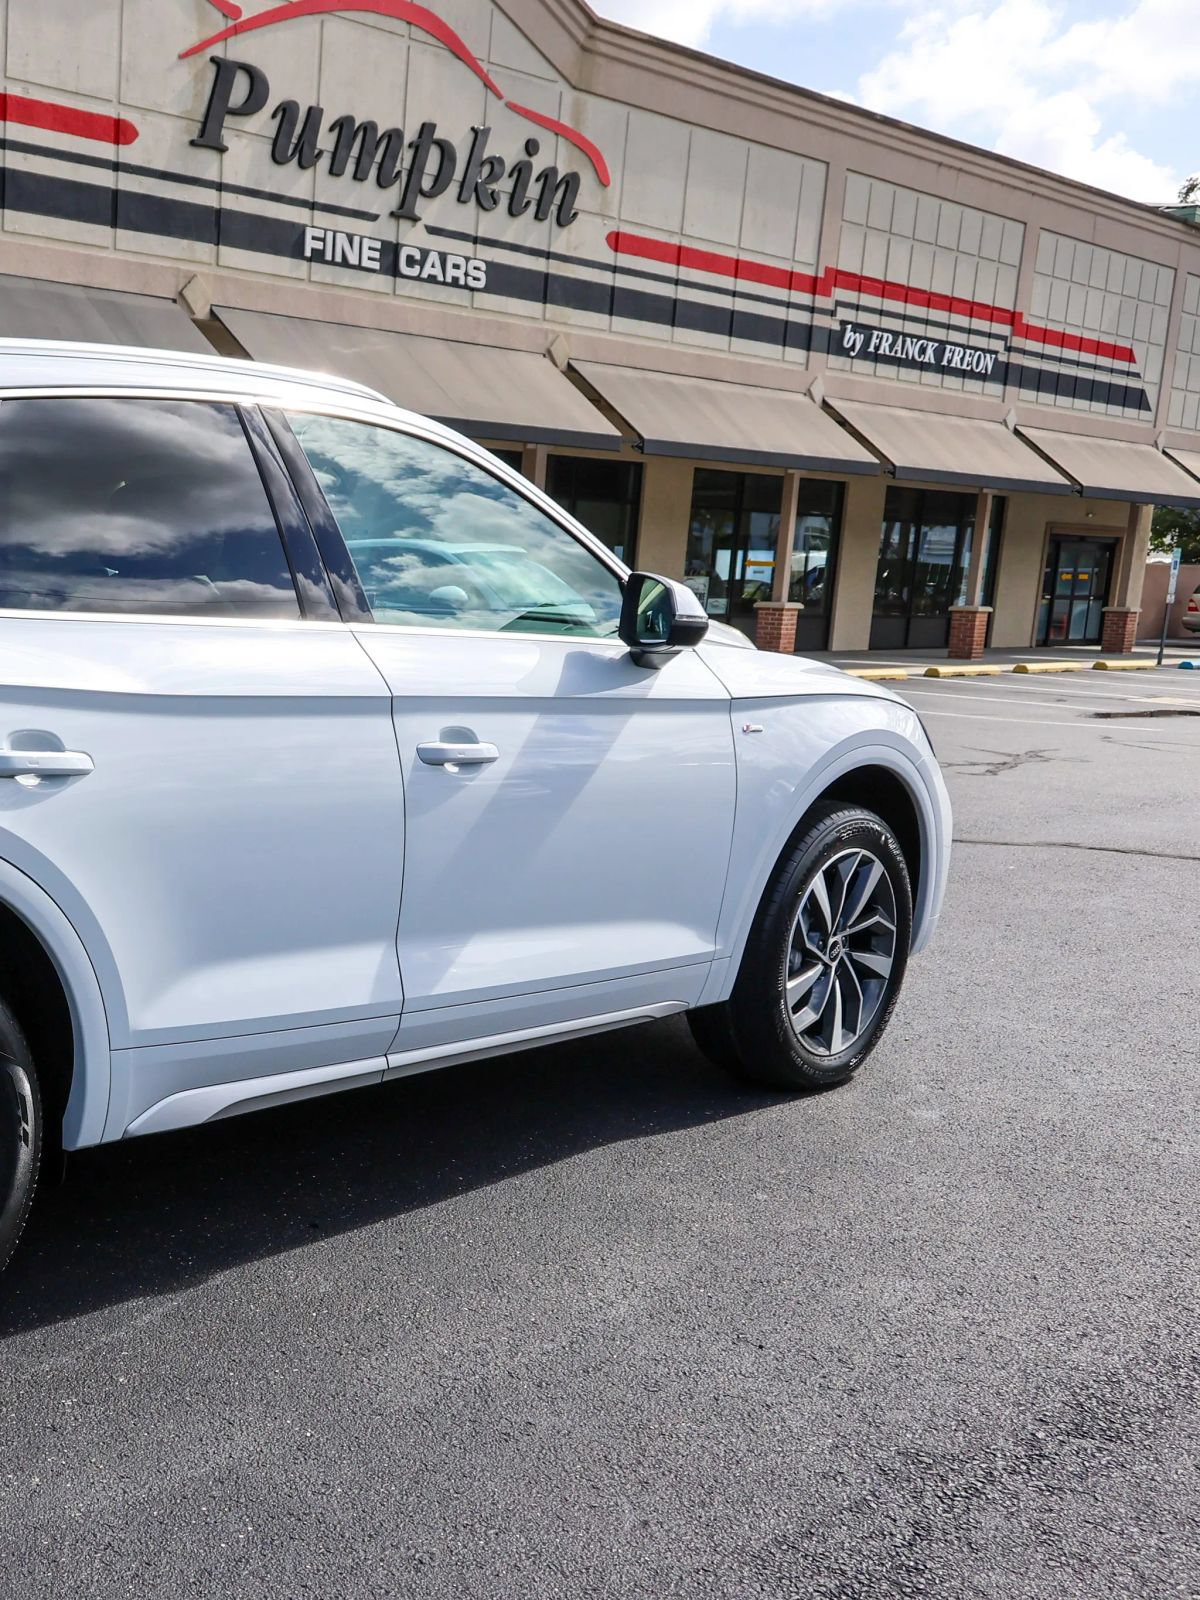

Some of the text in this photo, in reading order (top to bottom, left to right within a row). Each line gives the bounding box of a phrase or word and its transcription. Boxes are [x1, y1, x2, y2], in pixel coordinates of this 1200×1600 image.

[189, 55, 582, 228] Pumpkin
[303, 226, 487, 289] FINE CARS
[842, 324, 996, 375] by FRANCK FREON
